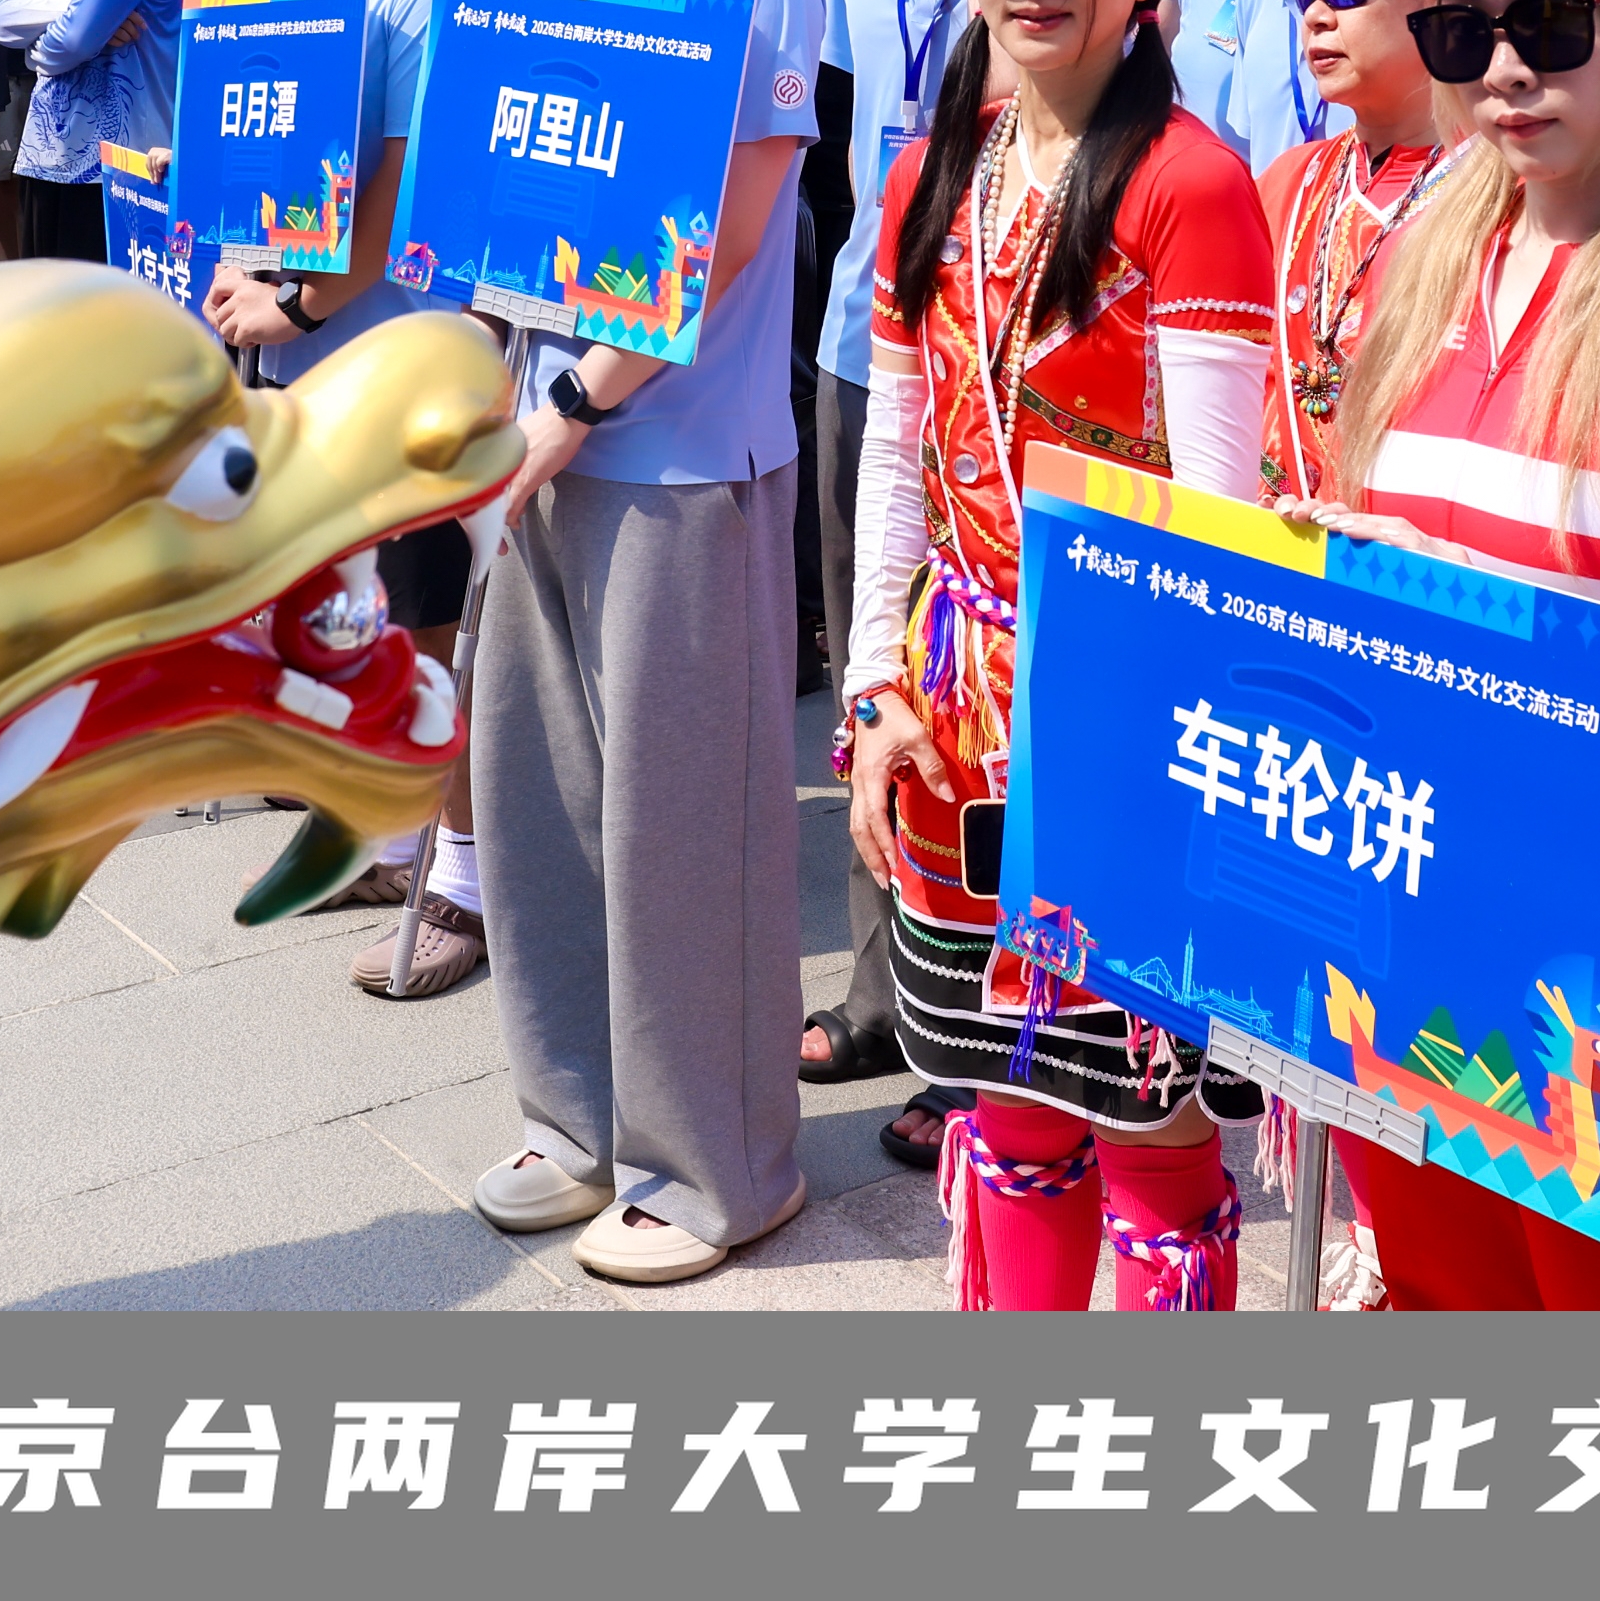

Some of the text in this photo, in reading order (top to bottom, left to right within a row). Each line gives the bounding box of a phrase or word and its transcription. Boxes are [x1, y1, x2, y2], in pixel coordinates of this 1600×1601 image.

[531, 20, 713, 62] 2026京台两岸大学生龙舟文化交流活动
[220, 81, 299, 139] 日月潭
[489, 86, 624, 178] 阿里山
[128, 238, 192, 308] 北京大学
[1067, 533, 1600, 735] 千载运河 青春竞渡 2026京台两岸大学生龙舟文化交流活动
[1168, 698, 1435, 898] 车轮饼
